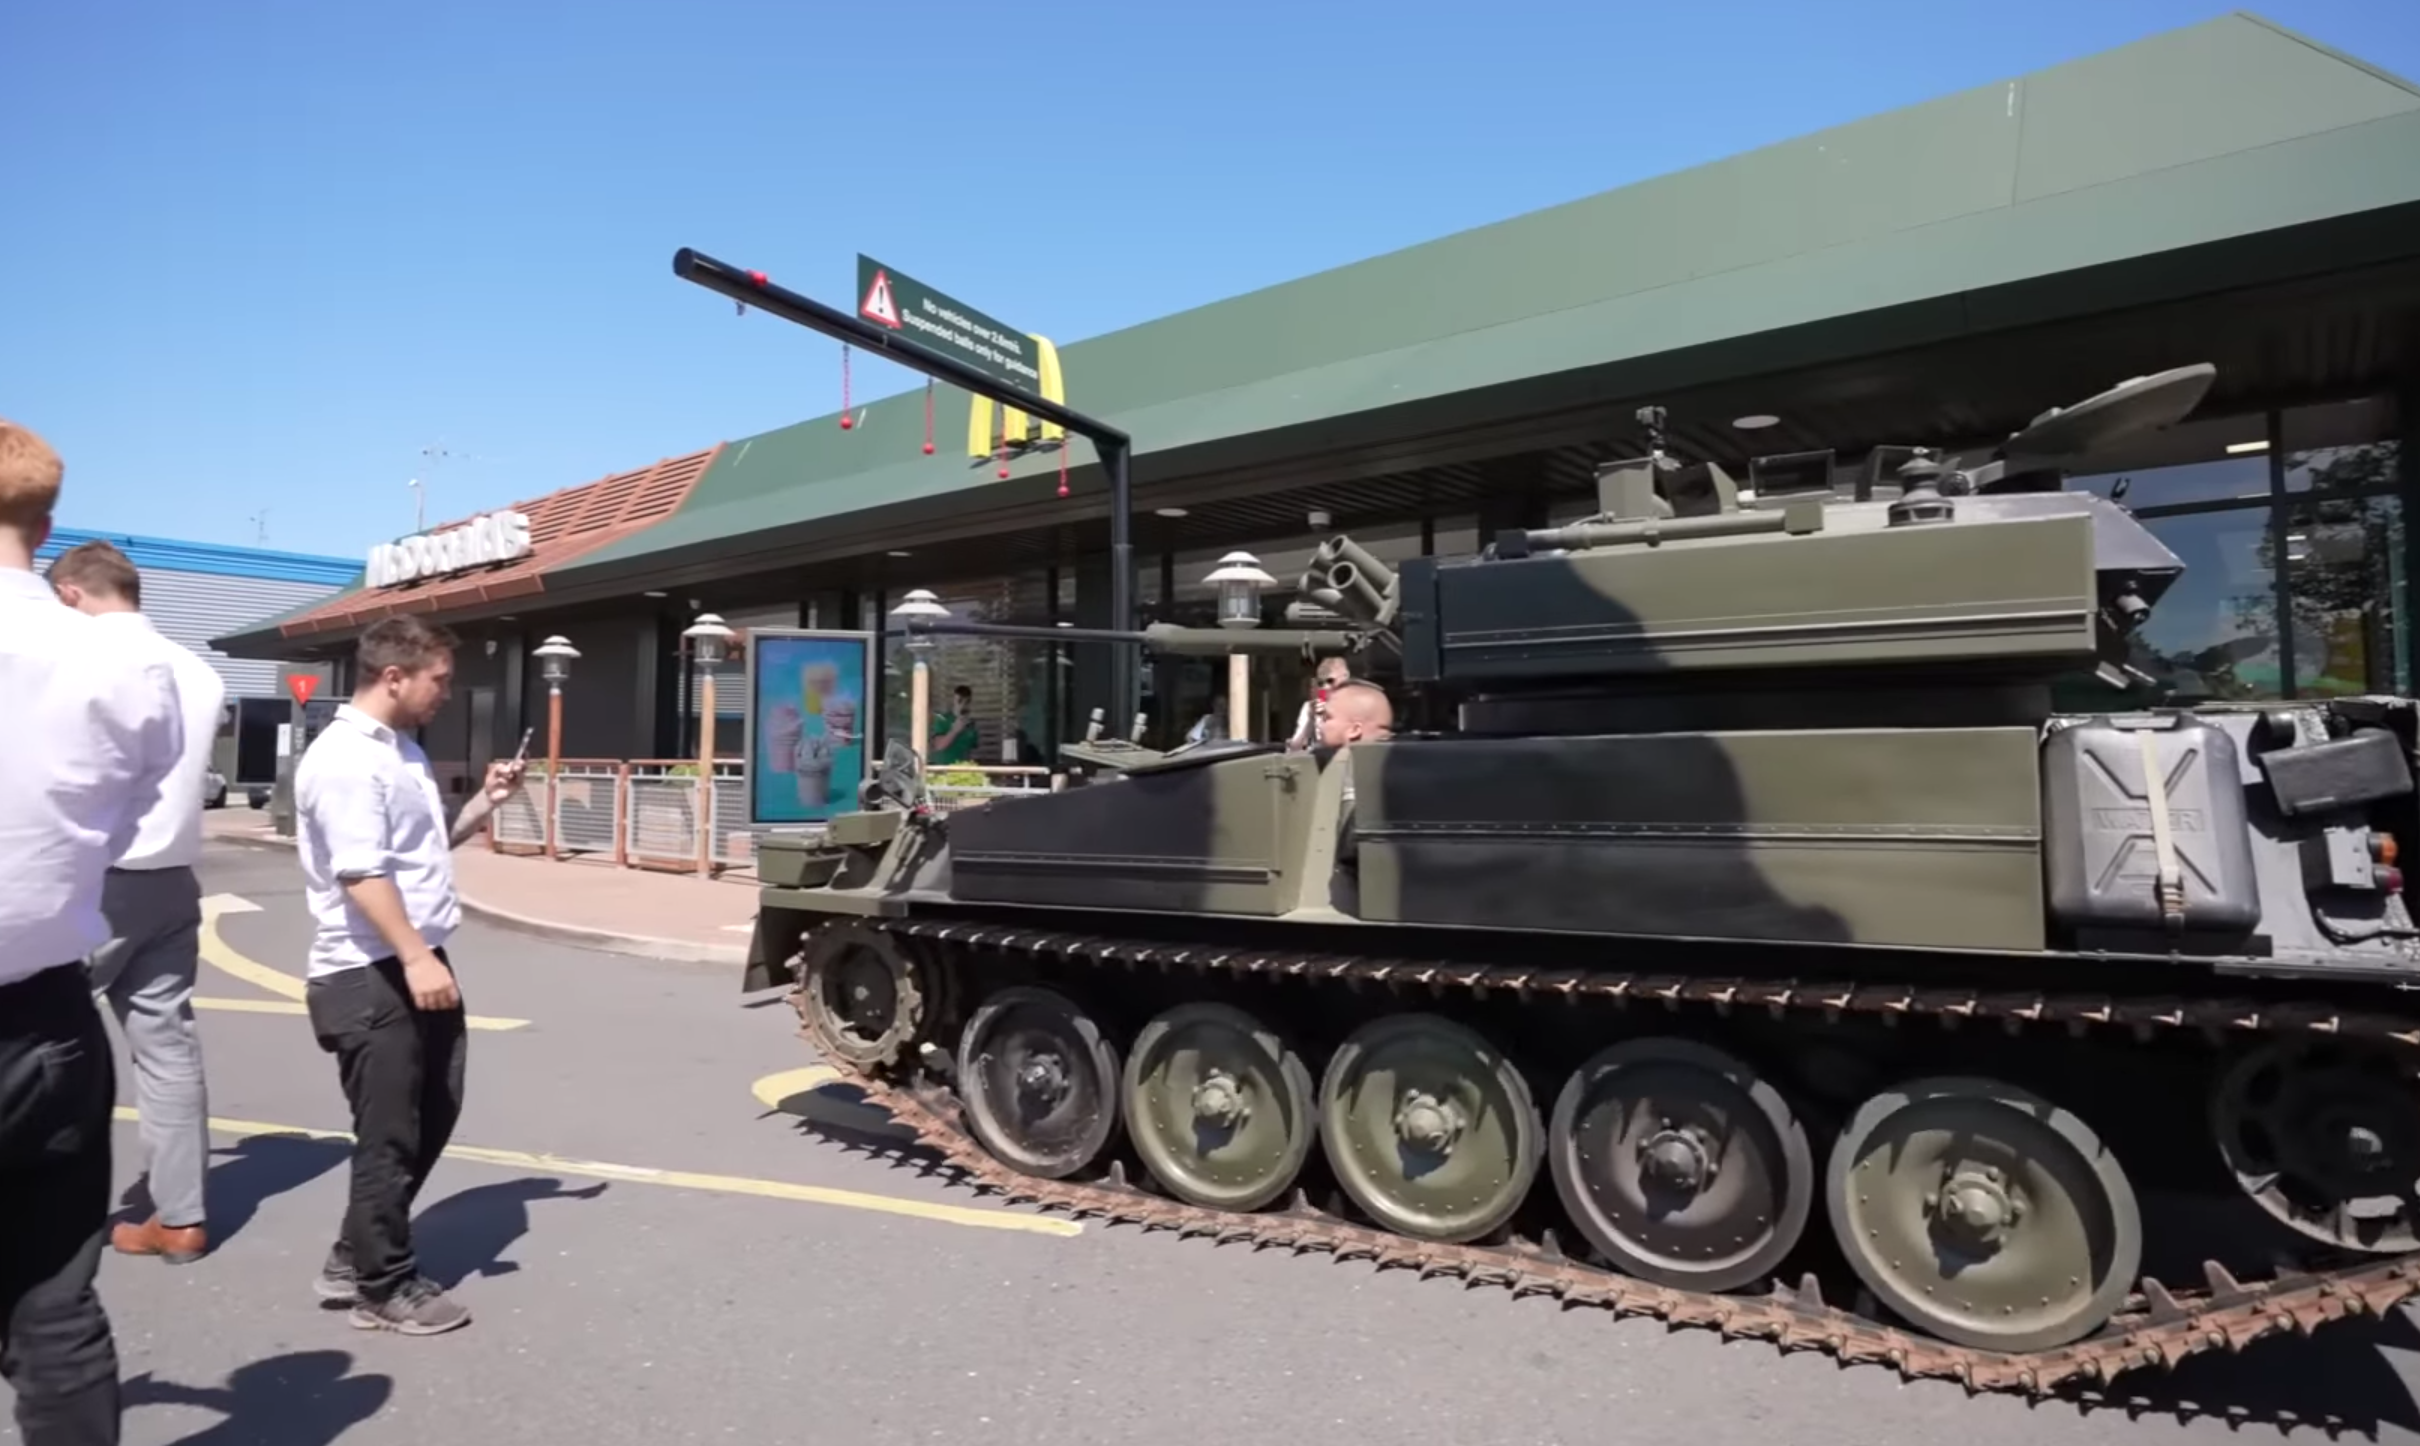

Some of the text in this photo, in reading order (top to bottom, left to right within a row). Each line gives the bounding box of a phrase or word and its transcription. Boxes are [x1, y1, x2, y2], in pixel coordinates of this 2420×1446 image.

[902, 308, 953, 341] Suspended
[975, 343, 992, 361] only
[993, 349, 1004, 364] for
[922, 297, 937, 315] No
[938, 307, 972, 331] vehicles
[973, 324, 990, 340] over
[298, 679, 306, 693] 1
